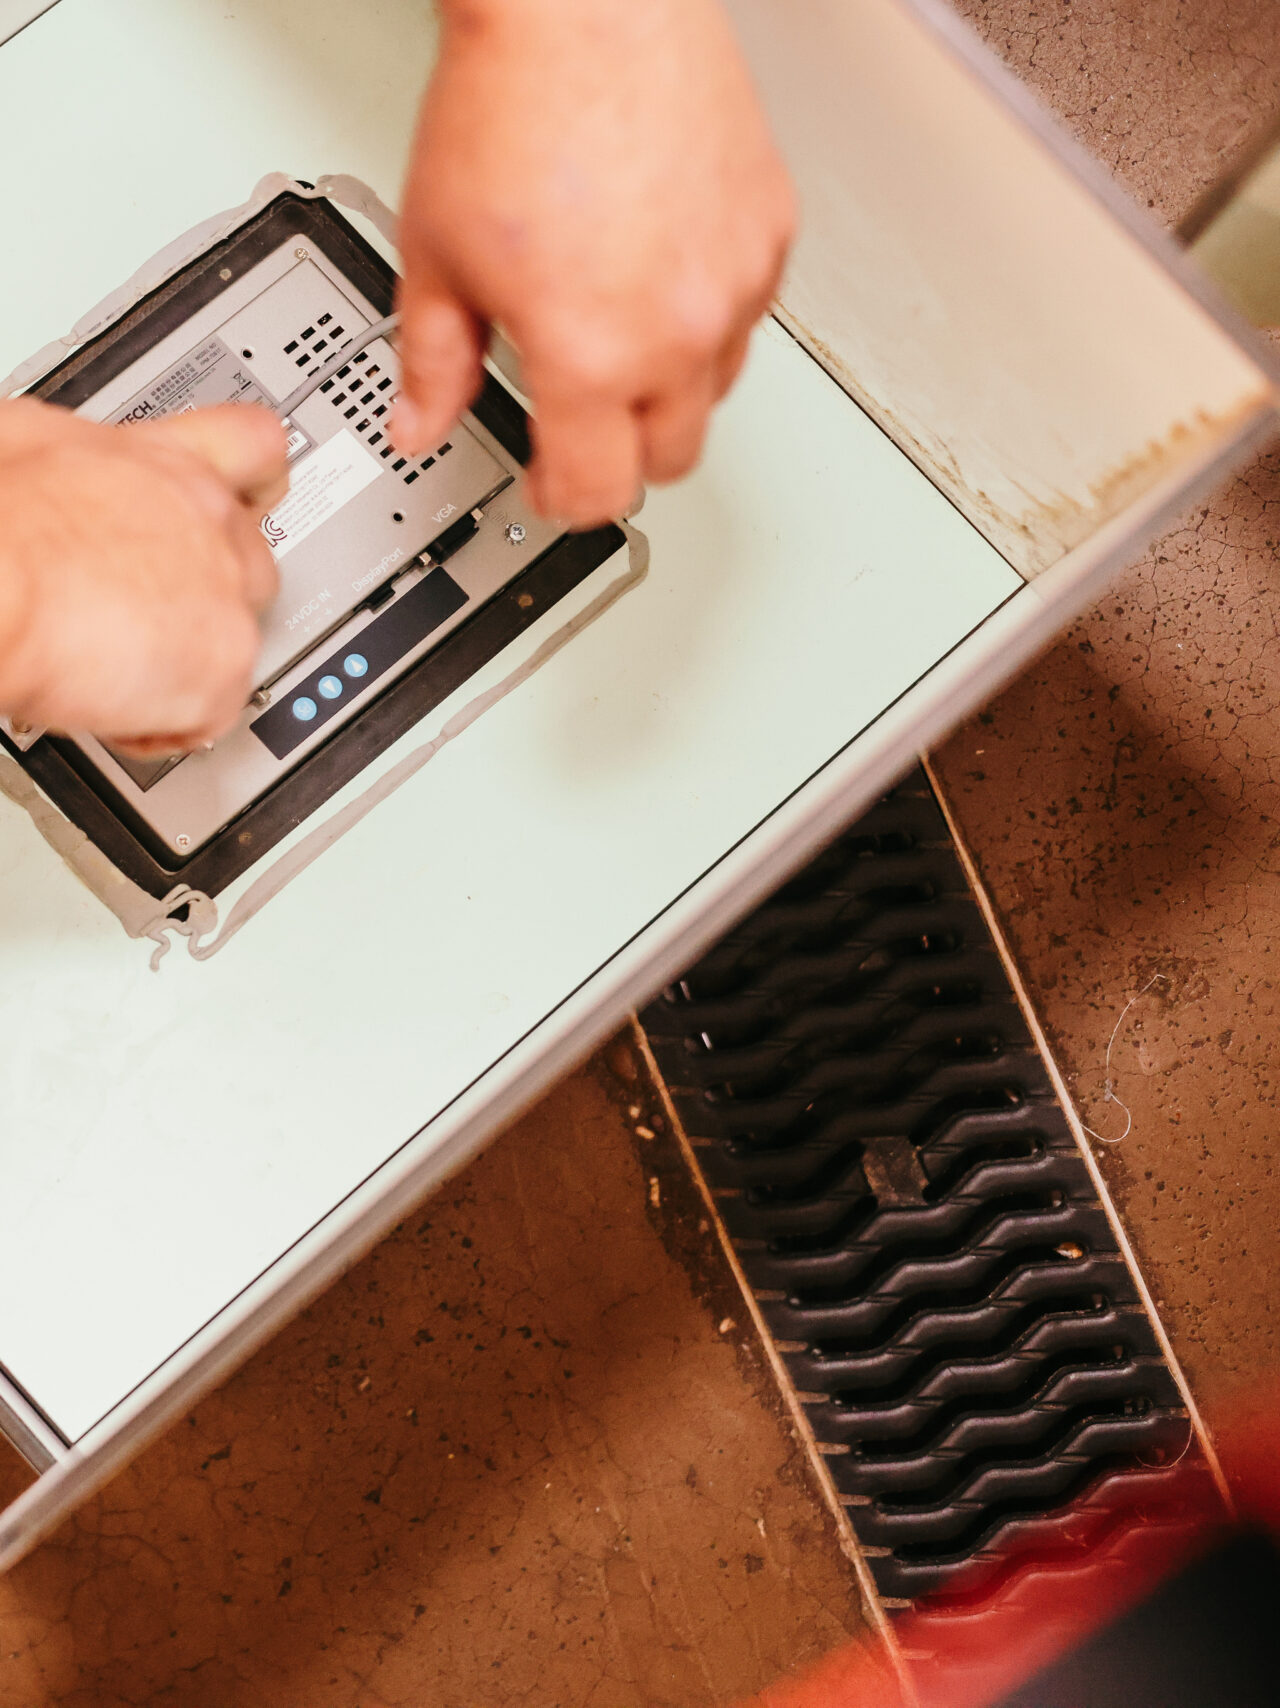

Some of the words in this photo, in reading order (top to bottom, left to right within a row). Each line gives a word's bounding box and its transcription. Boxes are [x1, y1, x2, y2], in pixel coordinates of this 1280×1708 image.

[115, 400, 153, 428] TECH
[432, 503, 457, 523] VGA
[351, 547, 404, 592] DisplayPort
[285, 598, 320, 631] 24VDC
[317, 587, 332, 604] IN
